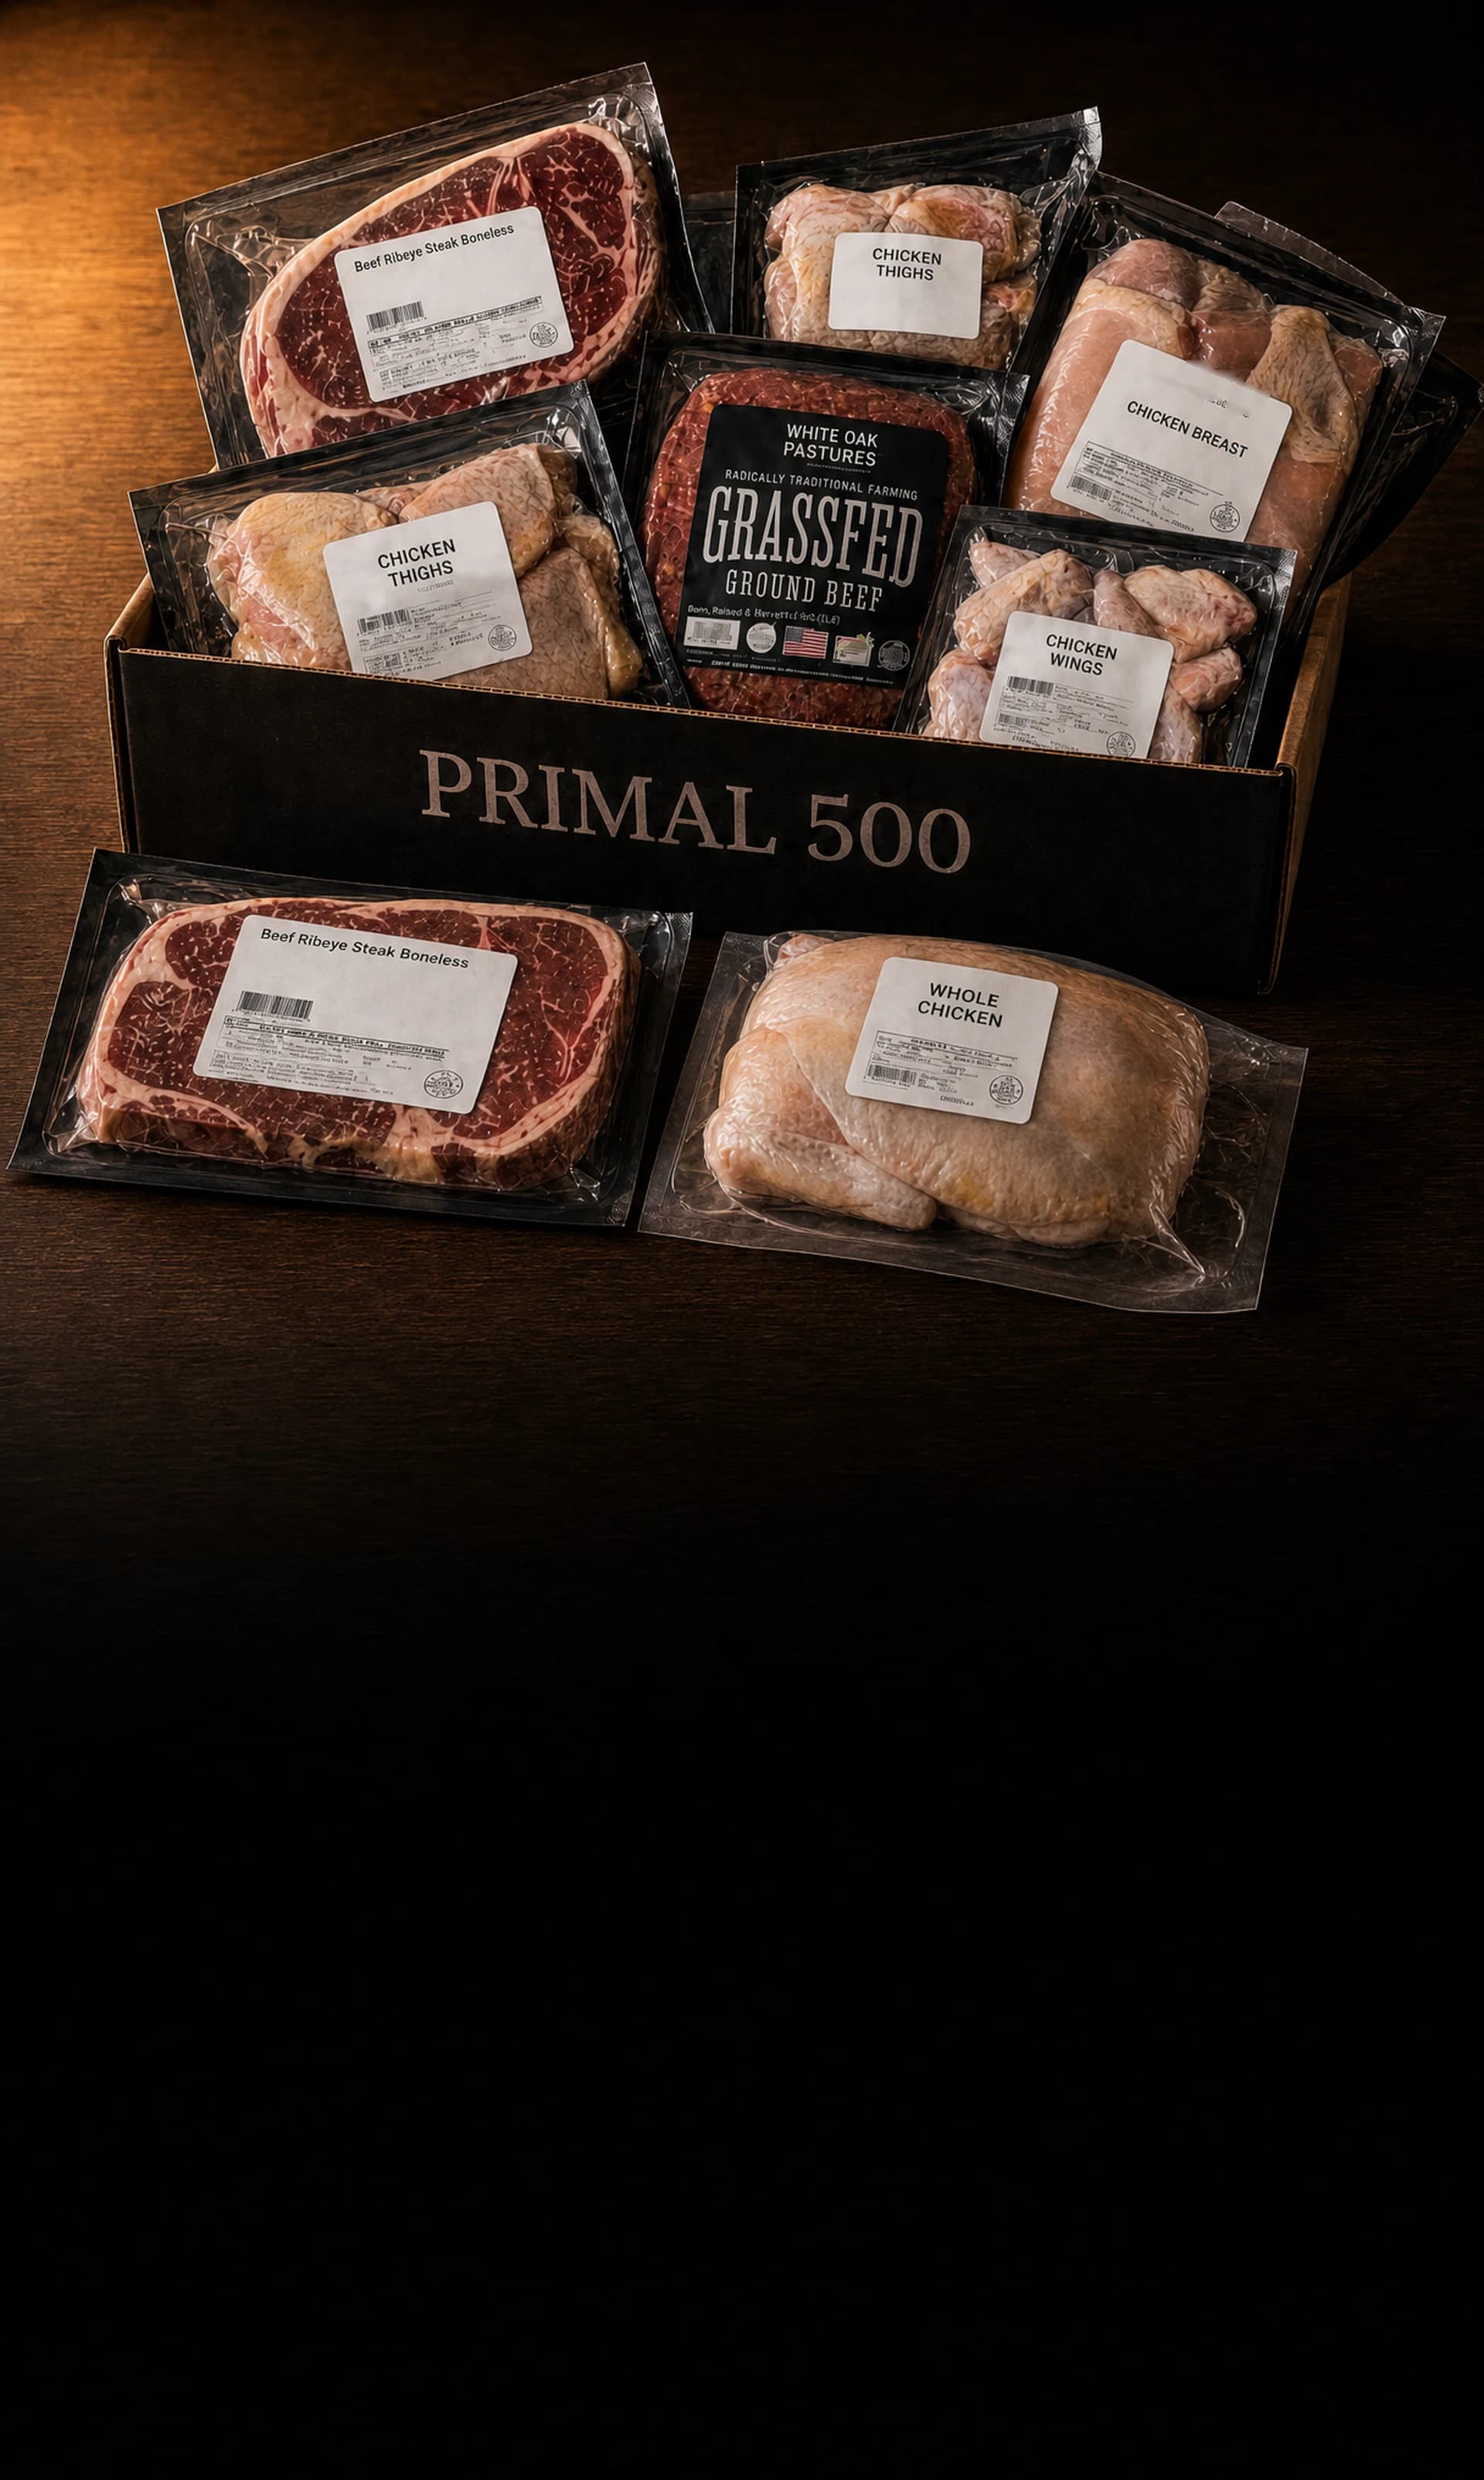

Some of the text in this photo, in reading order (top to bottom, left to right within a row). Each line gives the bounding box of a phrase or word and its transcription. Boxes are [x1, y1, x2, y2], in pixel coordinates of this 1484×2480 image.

[354, 223, 515, 272] Beef Ribeye Steak Boneless
[872, 247, 942, 265] CHICKEN
[876, 264, 934, 281] THIGHS
[787, 423, 879, 448] WHITE OAK
[1126, 400, 1248, 458] CHICKEN BREAST
[783, 441, 877, 467] PASTURES
[725, 468, 918, 501] RADICALLY TRADITIONAL FARMING
[702, 485, 924, 588] GRASSFED
[377, 539, 456, 569] CHICKEN
[387, 560, 454, 587] THIGHS
[725, 568, 883, 612] GROUND BEEF
[1046, 633, 1118, 660] CHICKEN
[1050, 652, 1104, 676] WINGS
[418, 748, 972, 874] PRIMAL 500
[260, 928, 469, 969] Beef Ribeye Steak Boneless
[929, 982, 999, 1008] WHOLE
[917, 1000, 1002, 1028] CHICKEN
